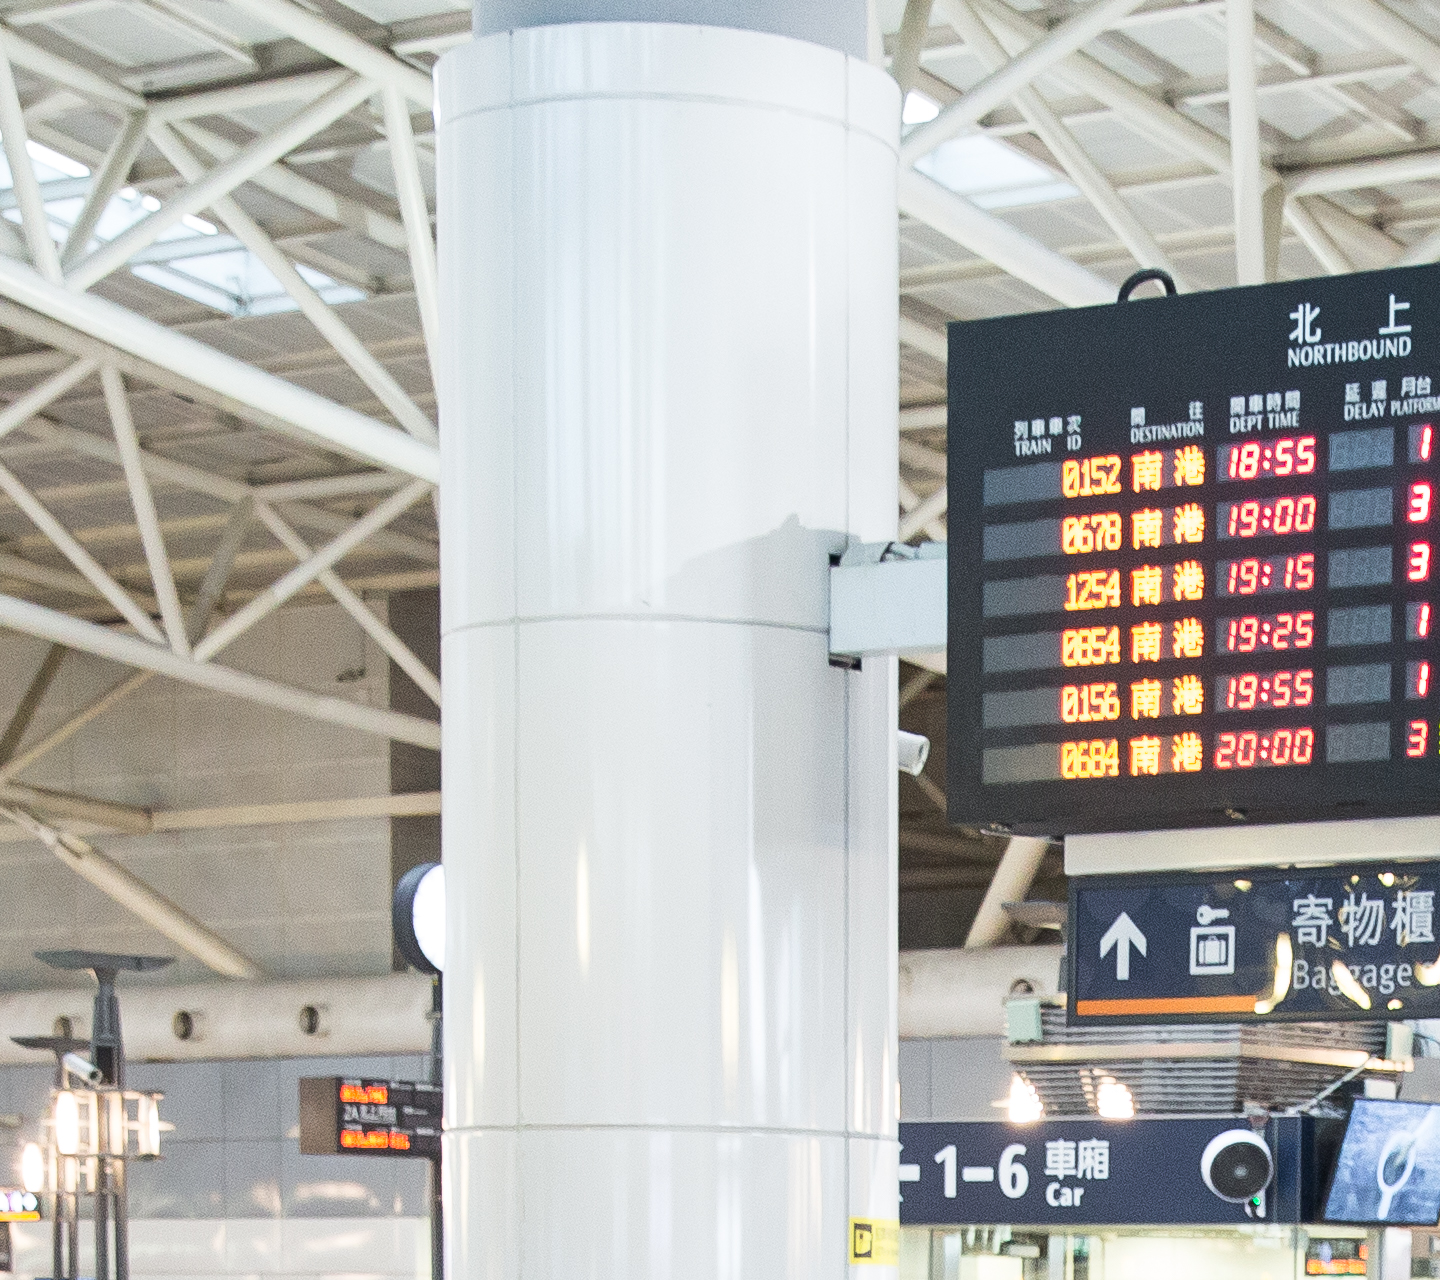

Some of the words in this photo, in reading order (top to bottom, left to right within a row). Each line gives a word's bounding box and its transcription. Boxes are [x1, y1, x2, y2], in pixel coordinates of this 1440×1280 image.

[1289, 293, 1412, 344] 北上
[1287, 336, 1412, 368] NORTHBOUND
[1131, 421, 1204, 444] DESTINATION
[1230, 415, 1262, 433] DEPT
[1267, 412, 1300, 430] TIME
[1344, 402, 1386, 421] DELAY
[1014, 438, 1052, 457] TRAIN
[1067, 434, 1082, 451] ID
[1062, 454, 1122, 498] 0152
[1131, 445, 1205, 493] 南港
[1228, 436, 1316, 479] 18:55
[1419, 424, 1433, 461] 1
[1062, 513, 1122, 555] 0678
[1131, 503, 1205, 550] 南港
[1228, 495, 1316, 538] 19:00
[1407, 481, 1432, 523] 3
[1064, 570, 1121, 611] 1254
[1131, 560, 1205, 606] 南港
[1228, 553, 1315, 595] 19:15
[1407, 541, 1431, 582] 3
[1062, 627, 1121, 667] 0854
[1130, 617, 1204, 663] 南港
[1227, 611, 1314, 653] 19:25
[1417, 602, 1431, 638] 1
[1062, 683, 1120, 723] 0156
[1130, 675, 1204, 720] 南港
[1227, 669, 1314, 710] 19:55
[1417, 661, 1430, 697] 1
[1062, 739, 1120, 780] 0684
[1130, 732, 1203, 777] 南港
[1215, 727, 1314, 770] 20:00
[1406, 720, 1429, 758] 3
[1292, 890, 1435, 948] 寄物櫃
[1292, 959, 1412, 996] Bagage
[934, 1143, 1029, 1199] 1-6
[1045, 1139, 1109, 1179] 車廂
[1045, 1182, 1085, 1206] Car
